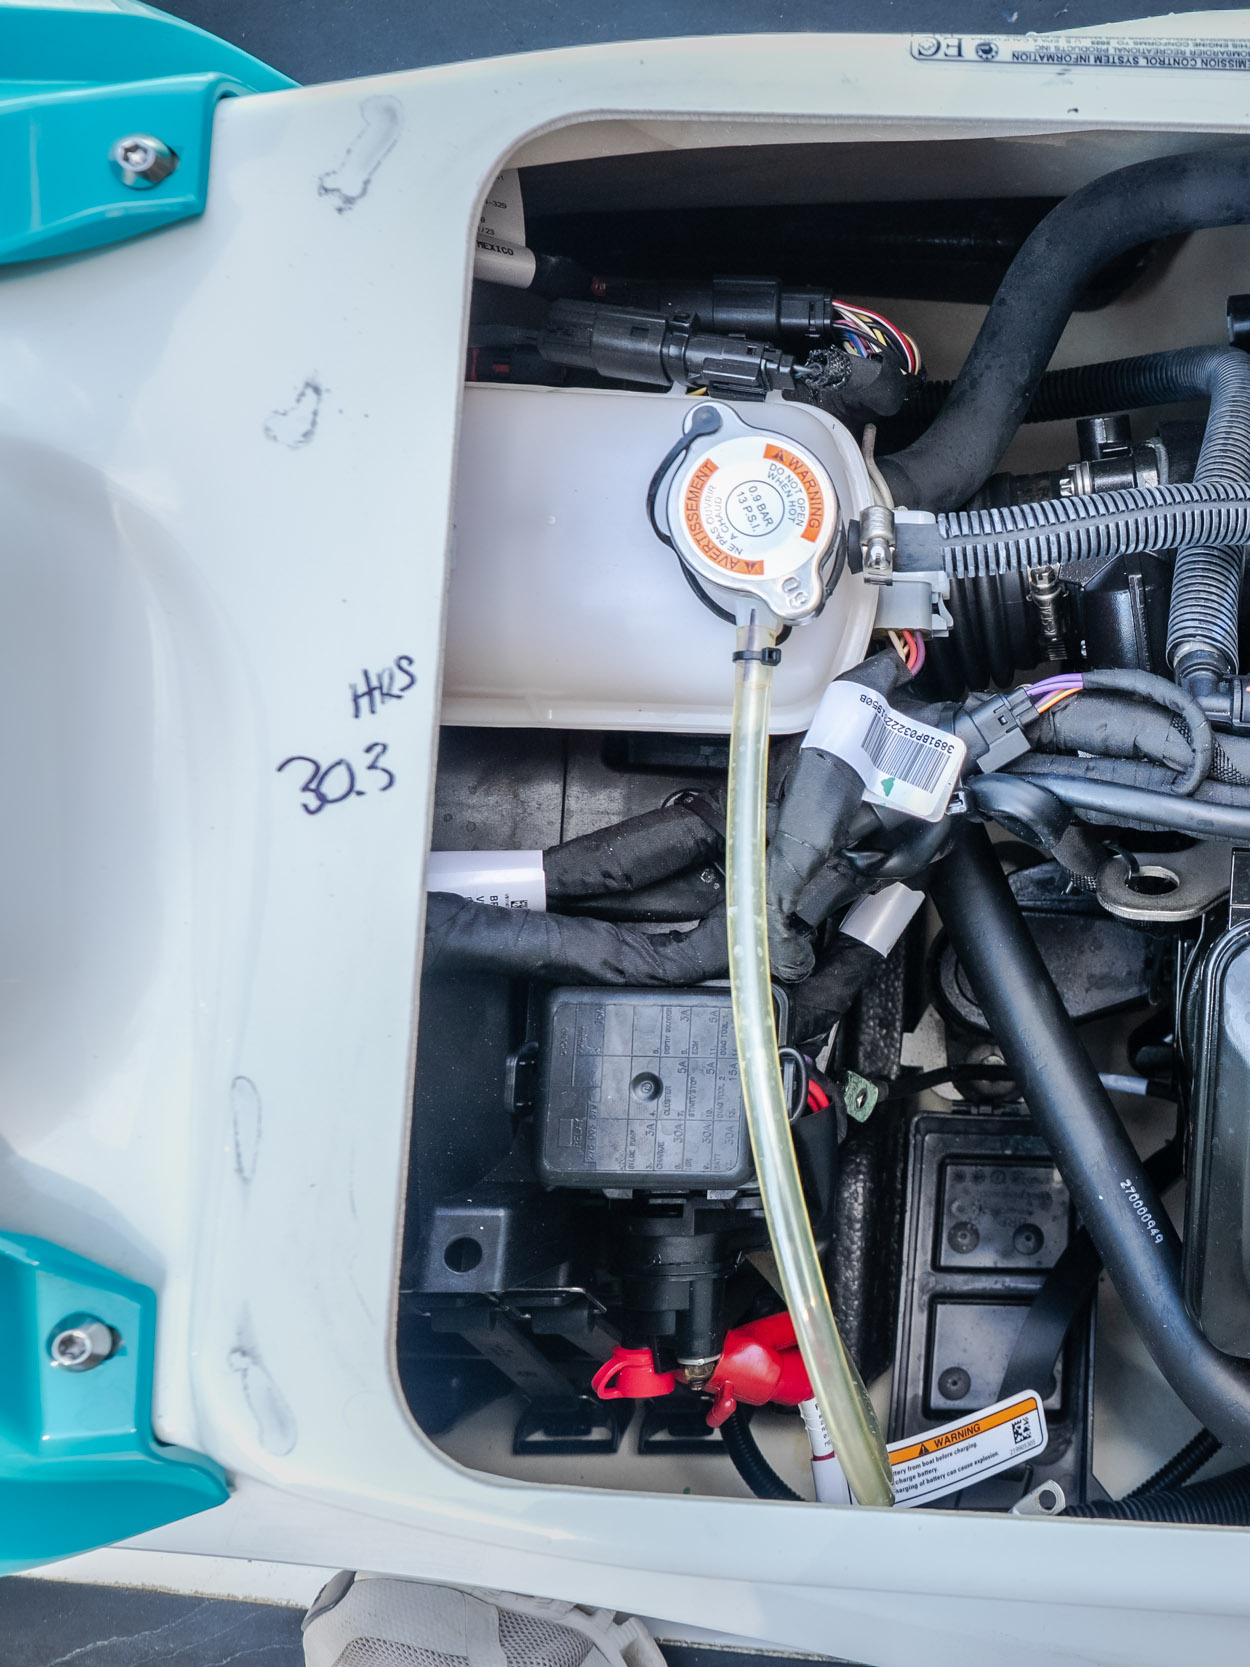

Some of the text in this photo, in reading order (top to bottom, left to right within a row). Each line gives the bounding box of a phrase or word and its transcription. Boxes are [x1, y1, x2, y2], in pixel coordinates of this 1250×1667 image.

[1011, 52, 1090, 64] INFORMATION
[1054, 45, 1109, 54] PRODUCTS
[1093, 54, 1139, 65] SYSTEM
[1113, 47, 1186, 56] RECREATIONAL
[1142, 55, 1197, 68] CONTROL
[478, 240, 514, 256] MEXICO
[767, 471, 797, 523] WHEN HOT
[770, 463, 807, 527] DO NOT OPEN
[789, 454, 822, 529] WARNING
[686, 462, 738, 569] AVERTISSEMENT
[718, 497, 730, 534] CHAUD
[736, 491, 757, 532] 13 P.S.I.
[749, 486, 774, 527] 0.9 BAR
[703, 485, 743, 555] NE PAS OUVRIR
[350, 656, 418, 718] HRS
[276, 742, 396, 815] 30.3
[680, 1009, 689, 1022] 3A
[709, 1010, 718, 1023] 5A
[677, 1060, 686, 1073] 5A
[705, 1062, 714, 1075] 5A
[645, 1123, 654, 1136] 3A
[674, 1123, 684, 1143] 30A
[702, 1123, 711, 1144] 30A
[725, 1126, 735, 1145] 30A
[1120, 1178, 1164, 1244] 270000949
[933, 1423, 980, 1448] WARNING
[907, 1442, 978, 1472] from boat before charging.
[894, 1467, 938, 1485] charge battery.
[895, 1451, 998, 1494] harging of battery can cause explosion.
